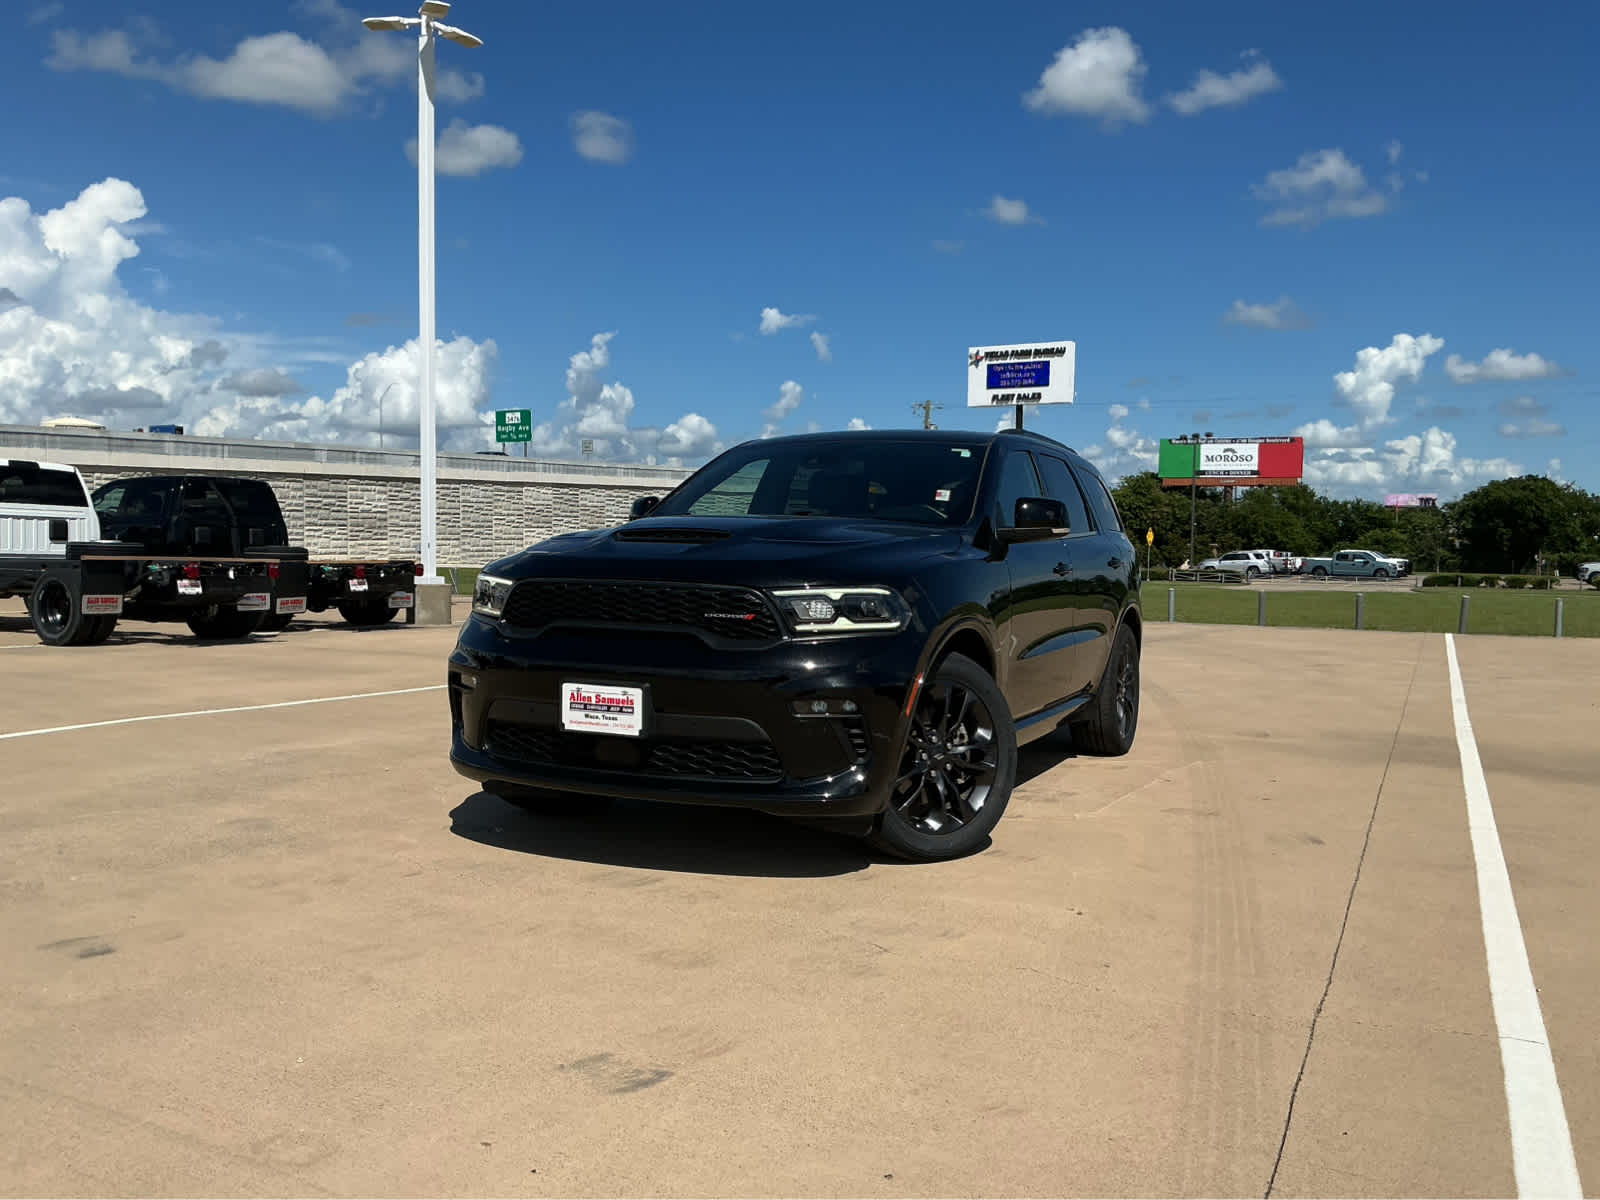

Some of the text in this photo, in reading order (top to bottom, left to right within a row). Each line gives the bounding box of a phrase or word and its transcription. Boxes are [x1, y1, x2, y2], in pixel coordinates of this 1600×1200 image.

[1033, 346, 1066, 358] BUREAU
[991, 392, 1041, 404] FLEET SALES
[1205, 454, 1253, 463] MOROSO
[570, 692, 634, 705] Allen Samuels
